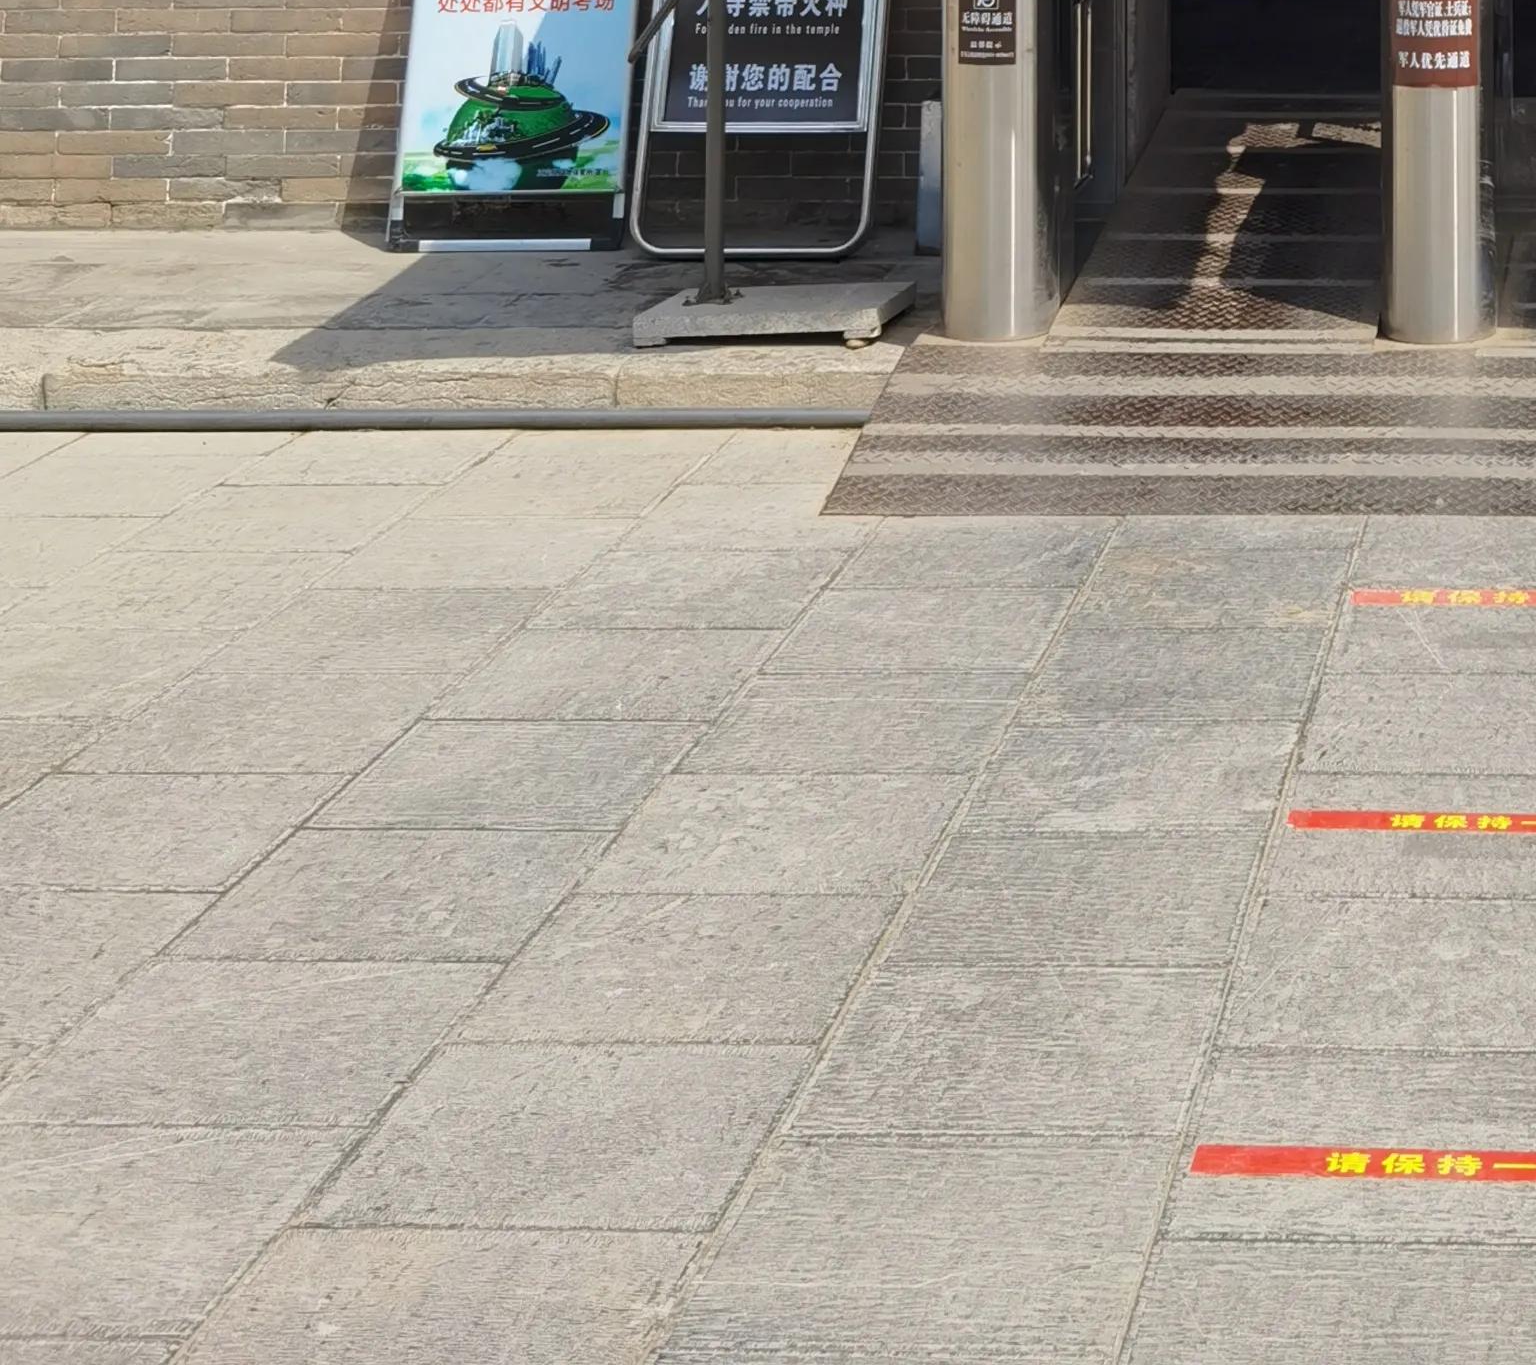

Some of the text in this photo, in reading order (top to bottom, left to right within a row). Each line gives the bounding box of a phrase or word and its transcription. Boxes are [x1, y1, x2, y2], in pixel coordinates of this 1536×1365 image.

[750, 23, 768, 35] fire
[772, 24, 782, 35] in
[785, 23, 801, 35] the
[806, 23, 840, 37] temple
[1397, 51, 1471, 69] 军人优先通道
[738, 96, 752, 108] for
[754, 98, 776, 110] your
[778, 96, 834, 110] cooperation
